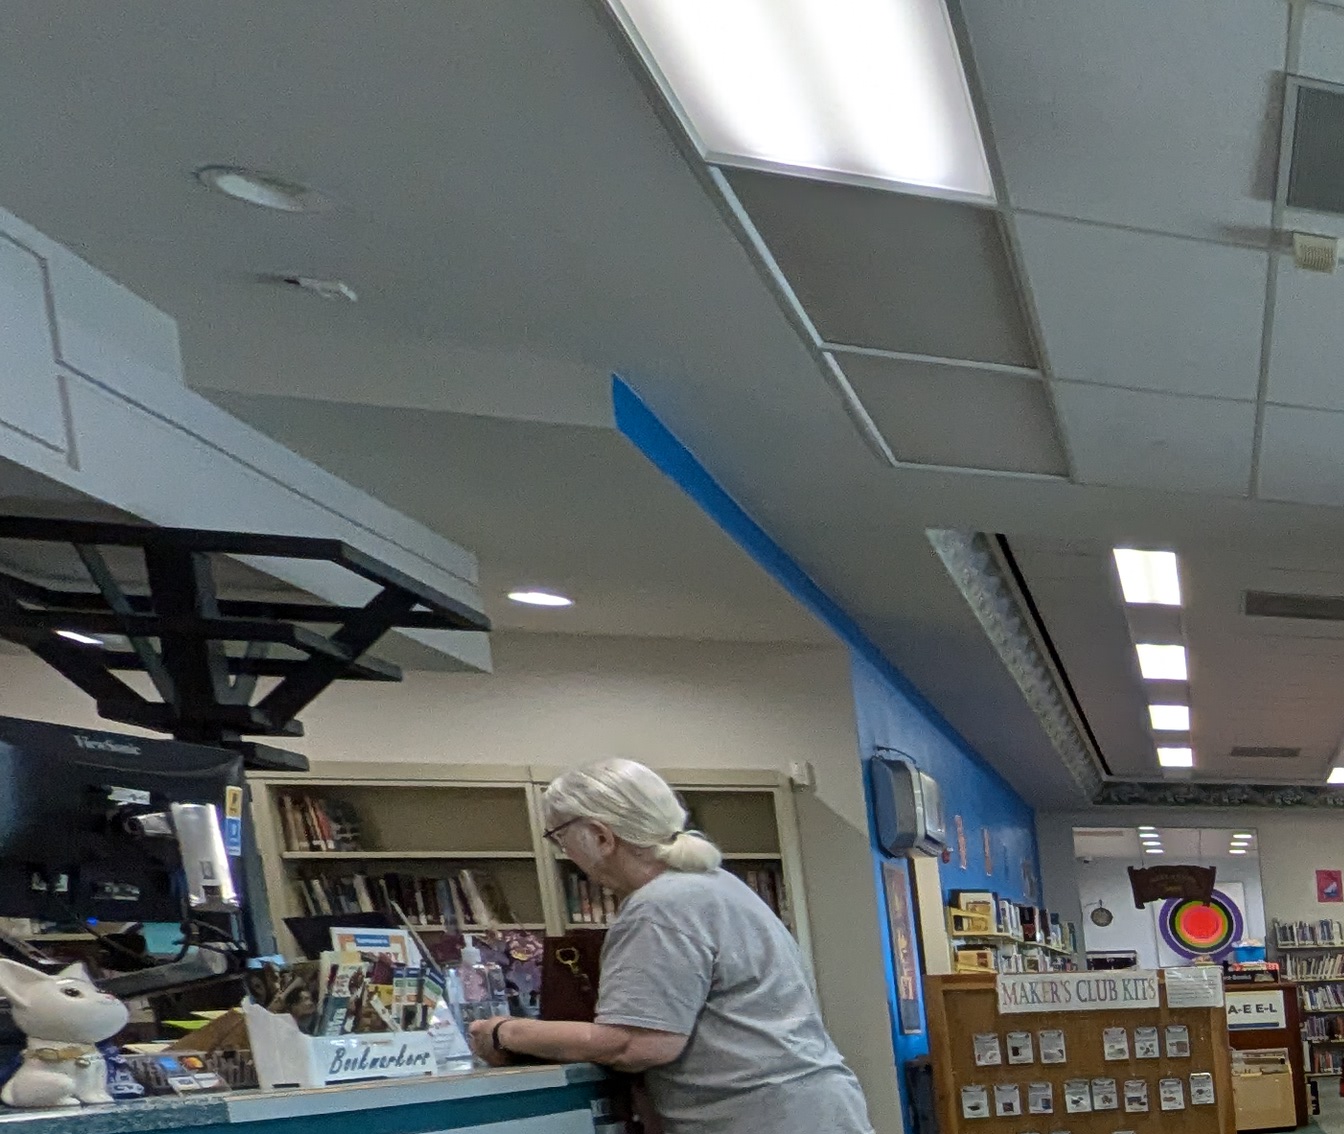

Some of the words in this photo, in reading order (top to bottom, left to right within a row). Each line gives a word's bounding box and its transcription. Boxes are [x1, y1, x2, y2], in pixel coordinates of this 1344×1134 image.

[1001, 979, 1071, 1005] MAKER'S
[1076, 978, 1118, 1003] CLUB
[1122, 978, 1156, 1001] KITS
[1228, 1004, 1252, 1015] A-E
[1255, 1003, 1278, 1013] E-L
